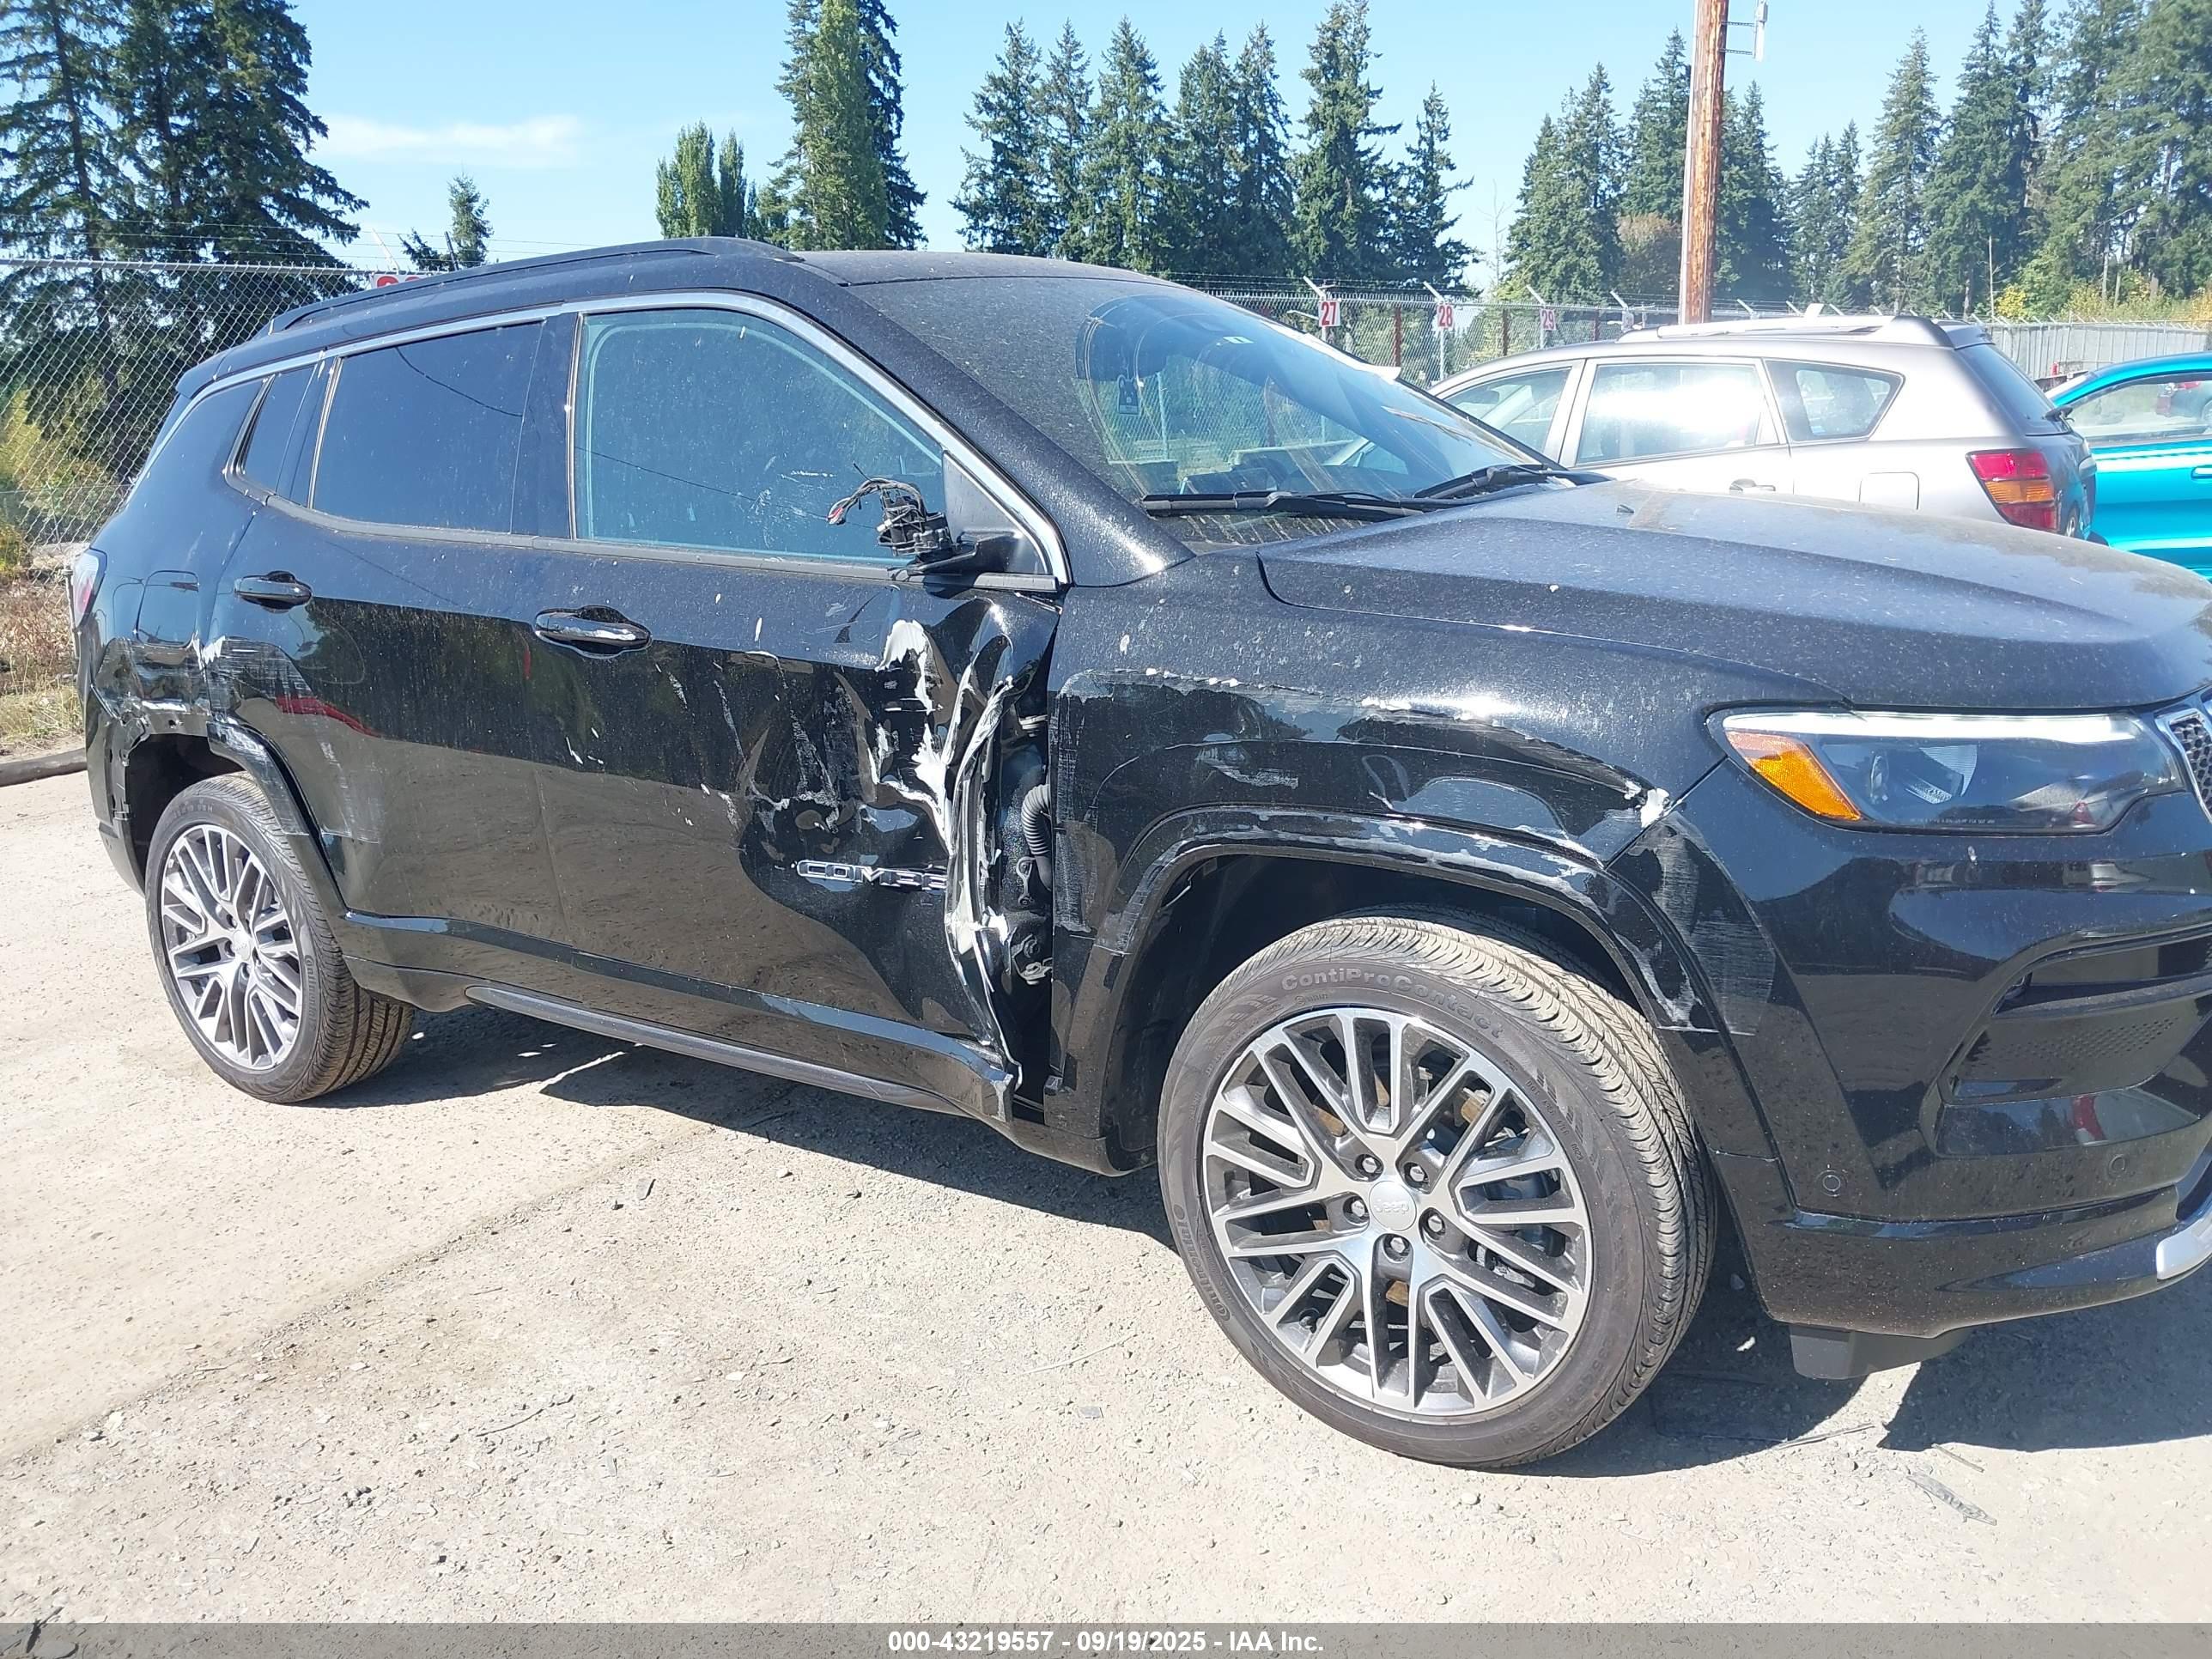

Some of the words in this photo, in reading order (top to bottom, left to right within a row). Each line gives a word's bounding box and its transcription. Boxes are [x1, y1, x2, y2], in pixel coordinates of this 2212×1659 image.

[1321, 301, 1337, 325] 27
[1437, 304, 1453, 327] 28
[1541, 309, 1554, 330] 29
[796, 860, 947, 890] COMPA
[1280, 967, 1504, 1039] ContiProContact
[1373, 1198, 1410, 1215] Jeep
